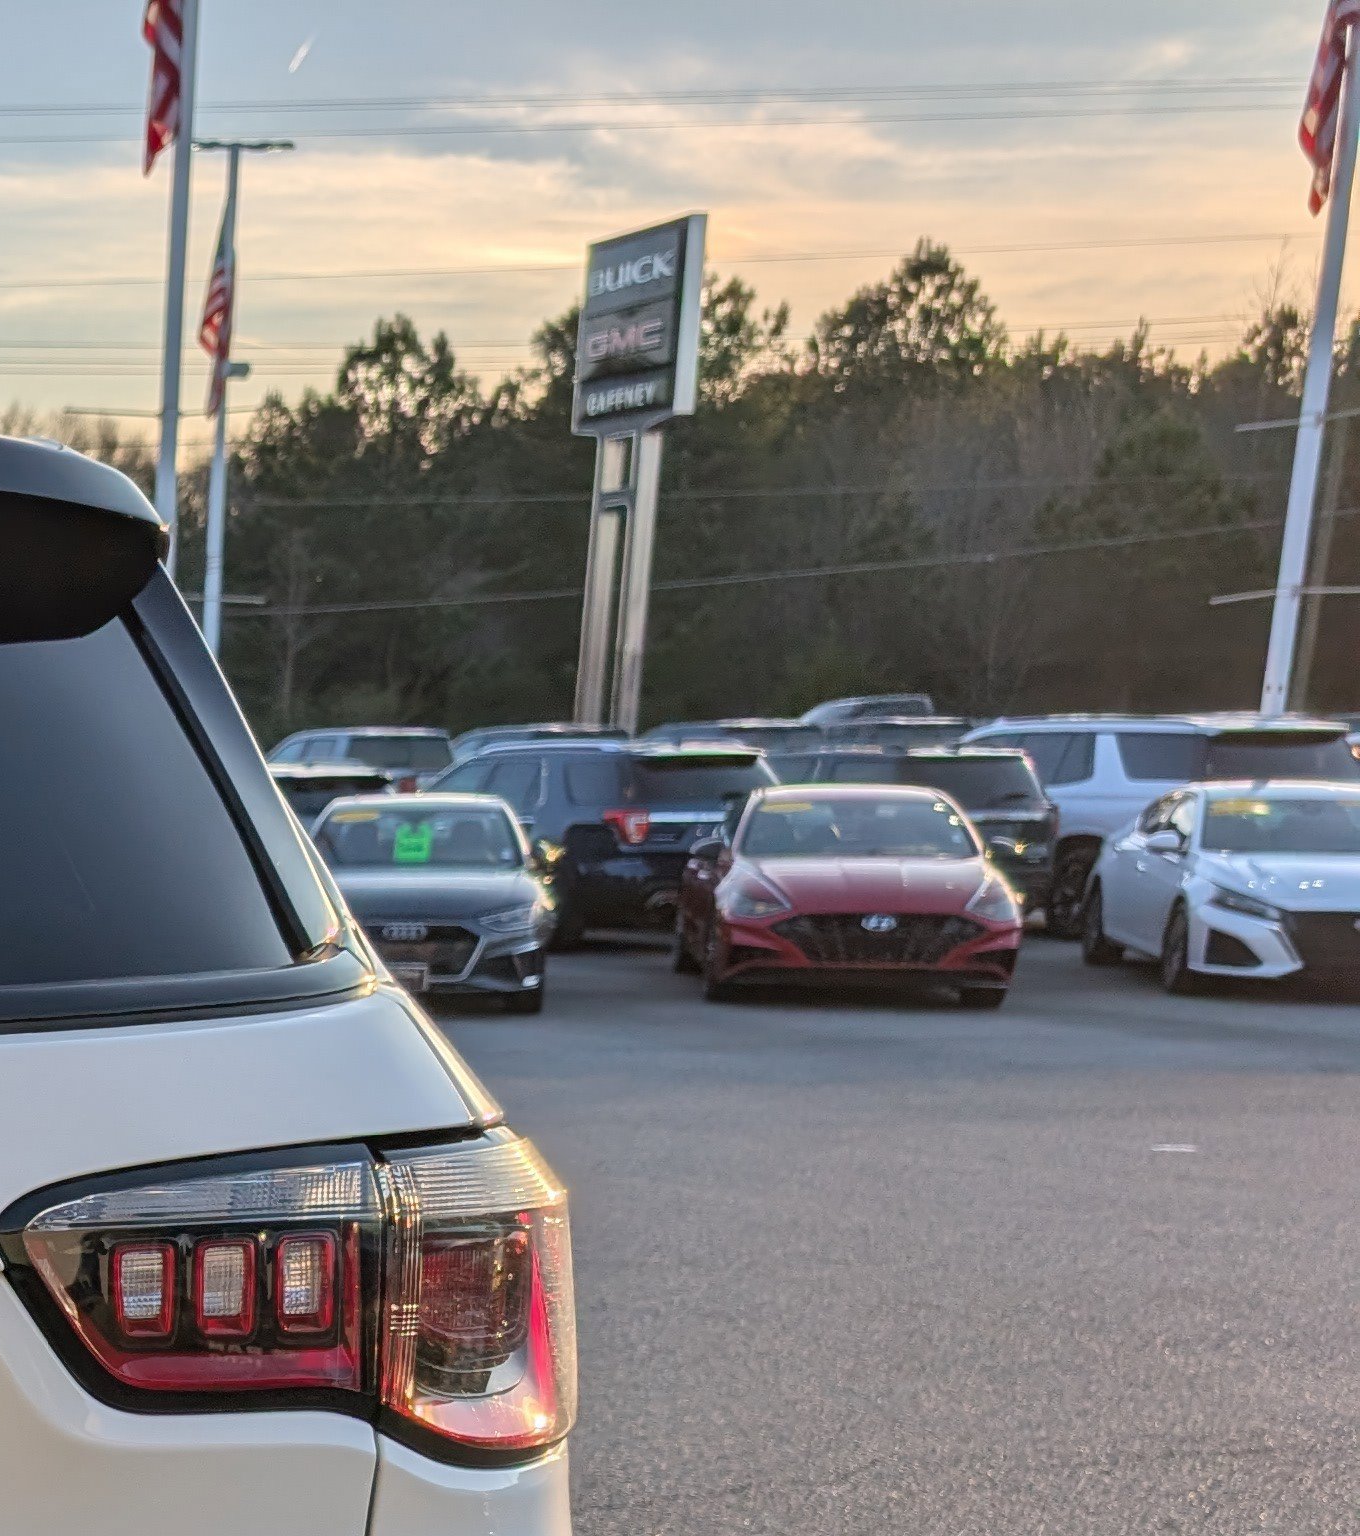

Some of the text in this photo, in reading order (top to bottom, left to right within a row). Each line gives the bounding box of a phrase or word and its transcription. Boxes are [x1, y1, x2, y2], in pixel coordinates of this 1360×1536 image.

[591, 251, 676, 296] BUICK
[586, 317, 664, 358] GMC
[586, 381, 656, 417] GAFFNEY
